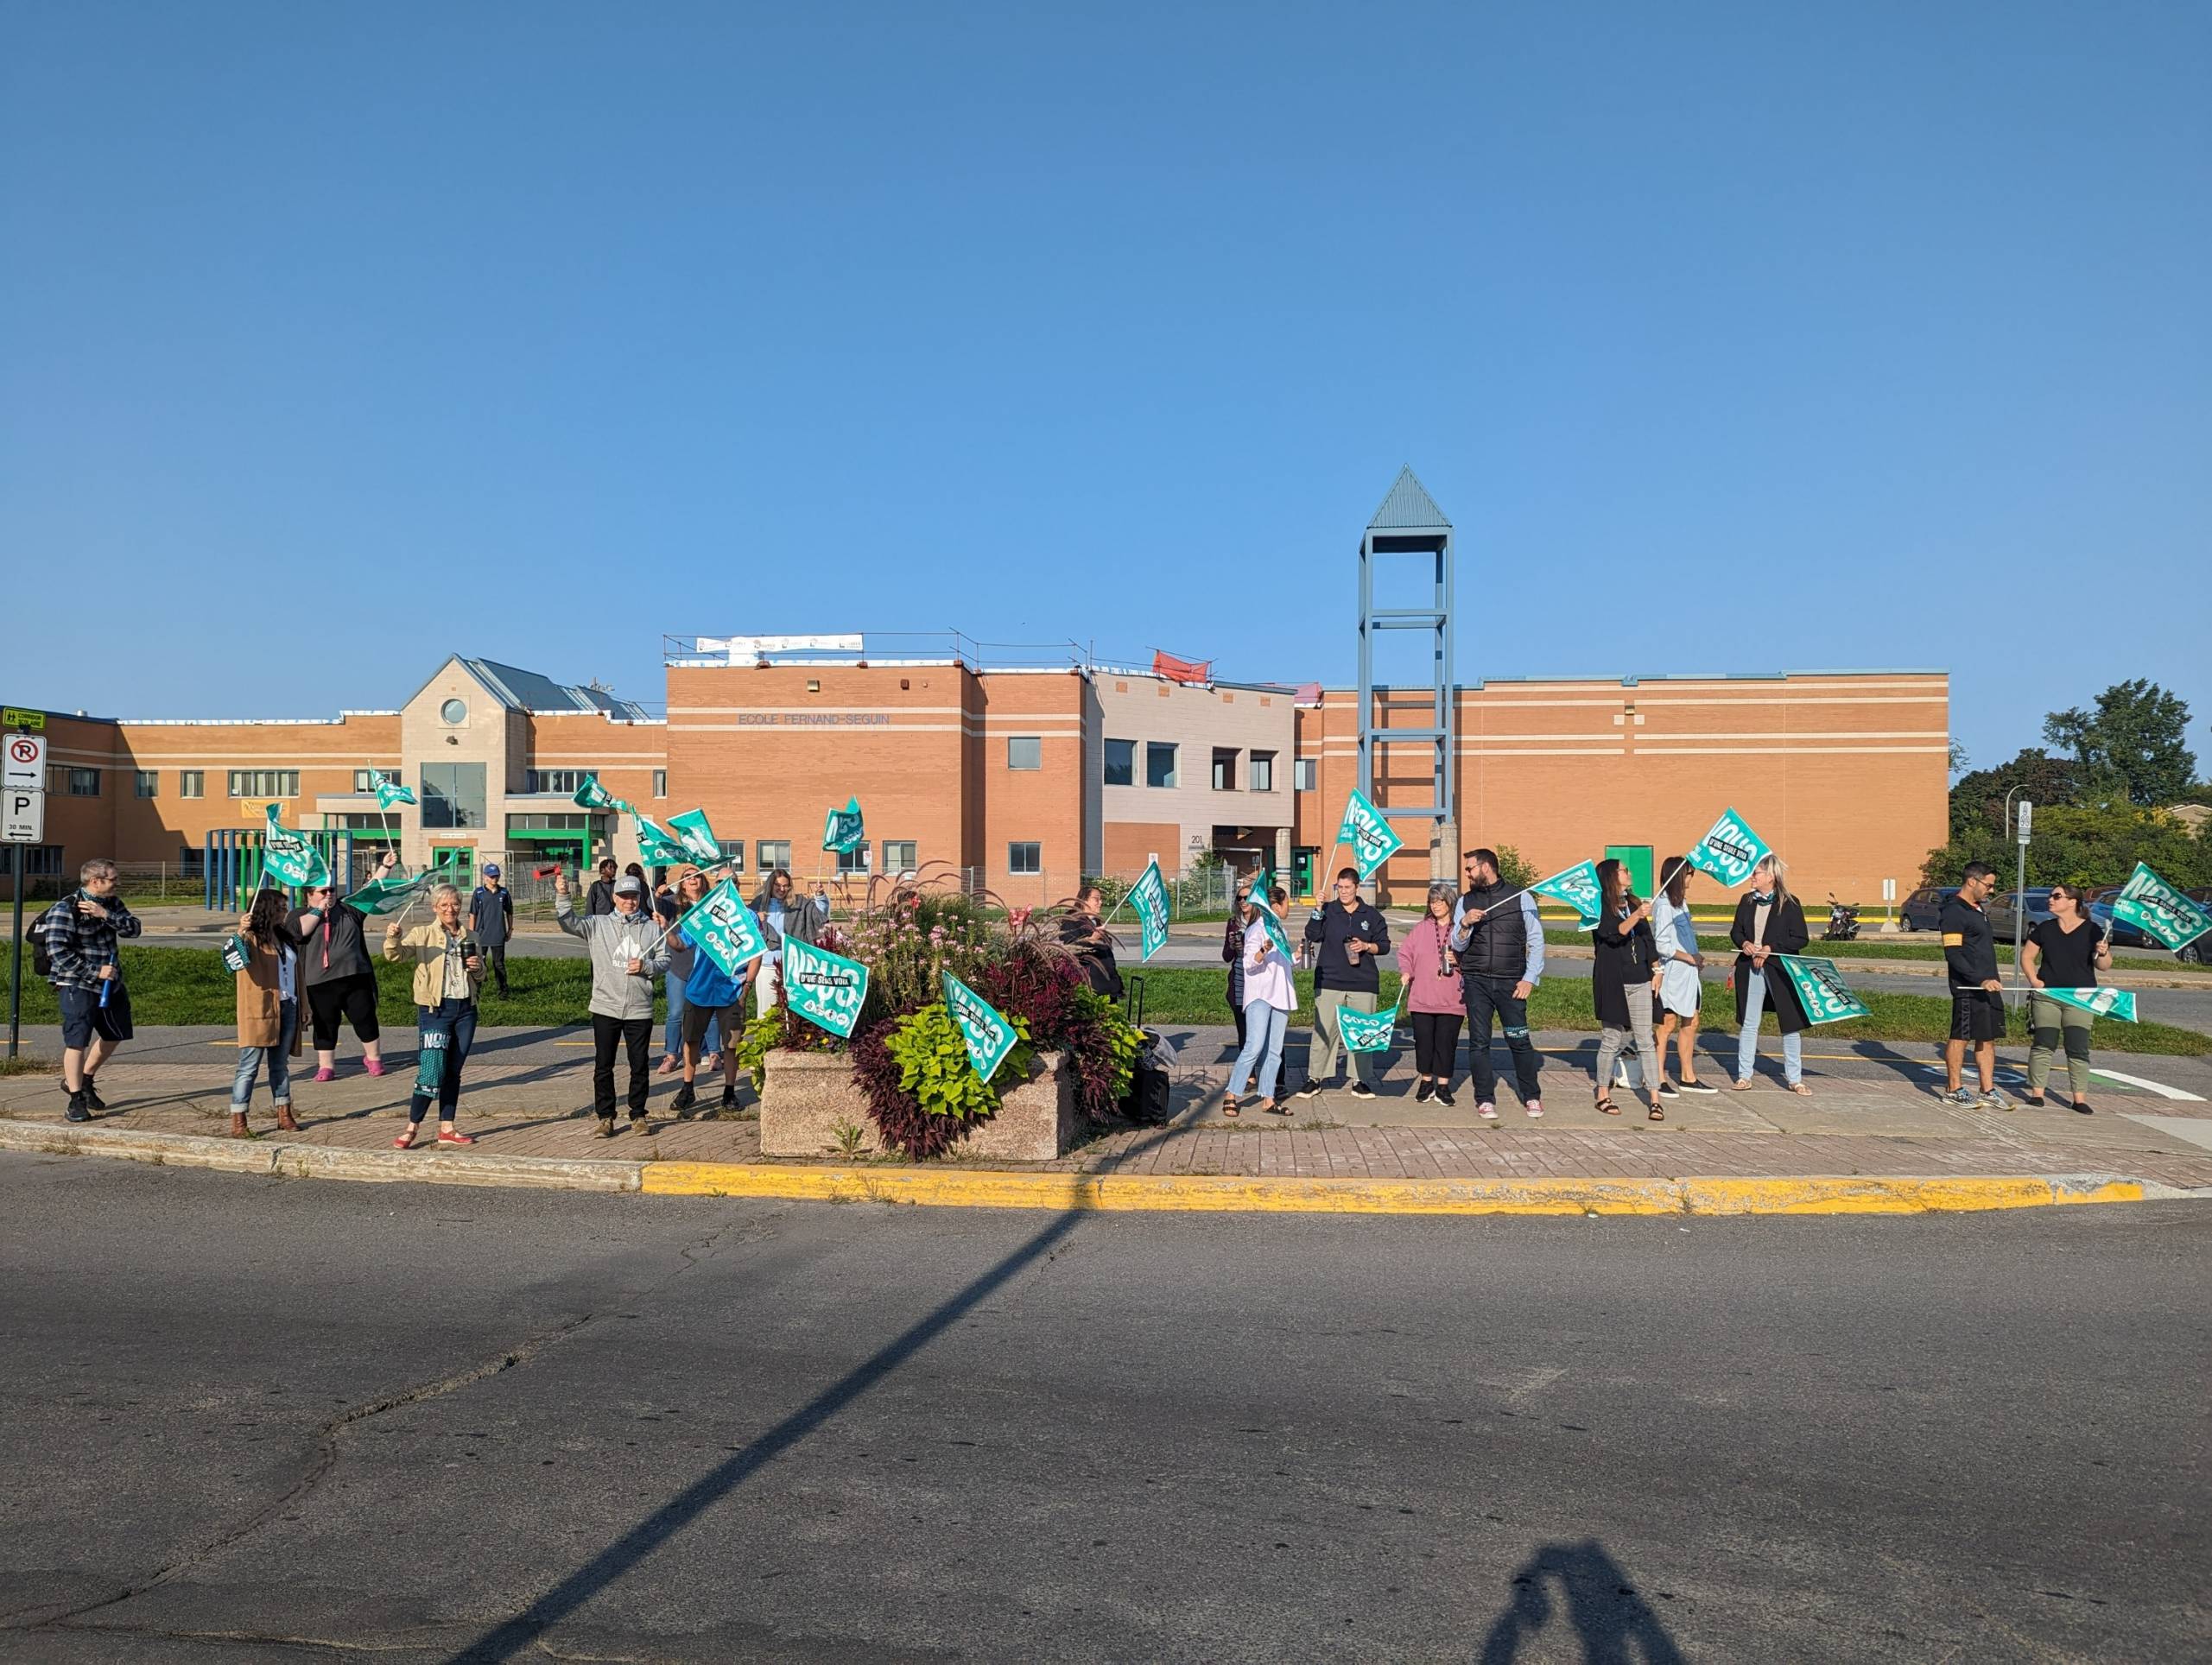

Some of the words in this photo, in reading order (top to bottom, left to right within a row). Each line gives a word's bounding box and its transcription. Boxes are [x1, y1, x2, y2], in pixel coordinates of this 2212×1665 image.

[18, 712, 42, 720] CORRIDOR
[738, 714, 777, 725] ECOLE
[784, 714, 890, 725] FERNAND-SEGUIN
[15, 797, 30, 815] P
[1702, 814, 1758, 877] NOUS
[2120, 872, 2202, 934] NOUS
[786, 943, 860, 1008] NOUS
